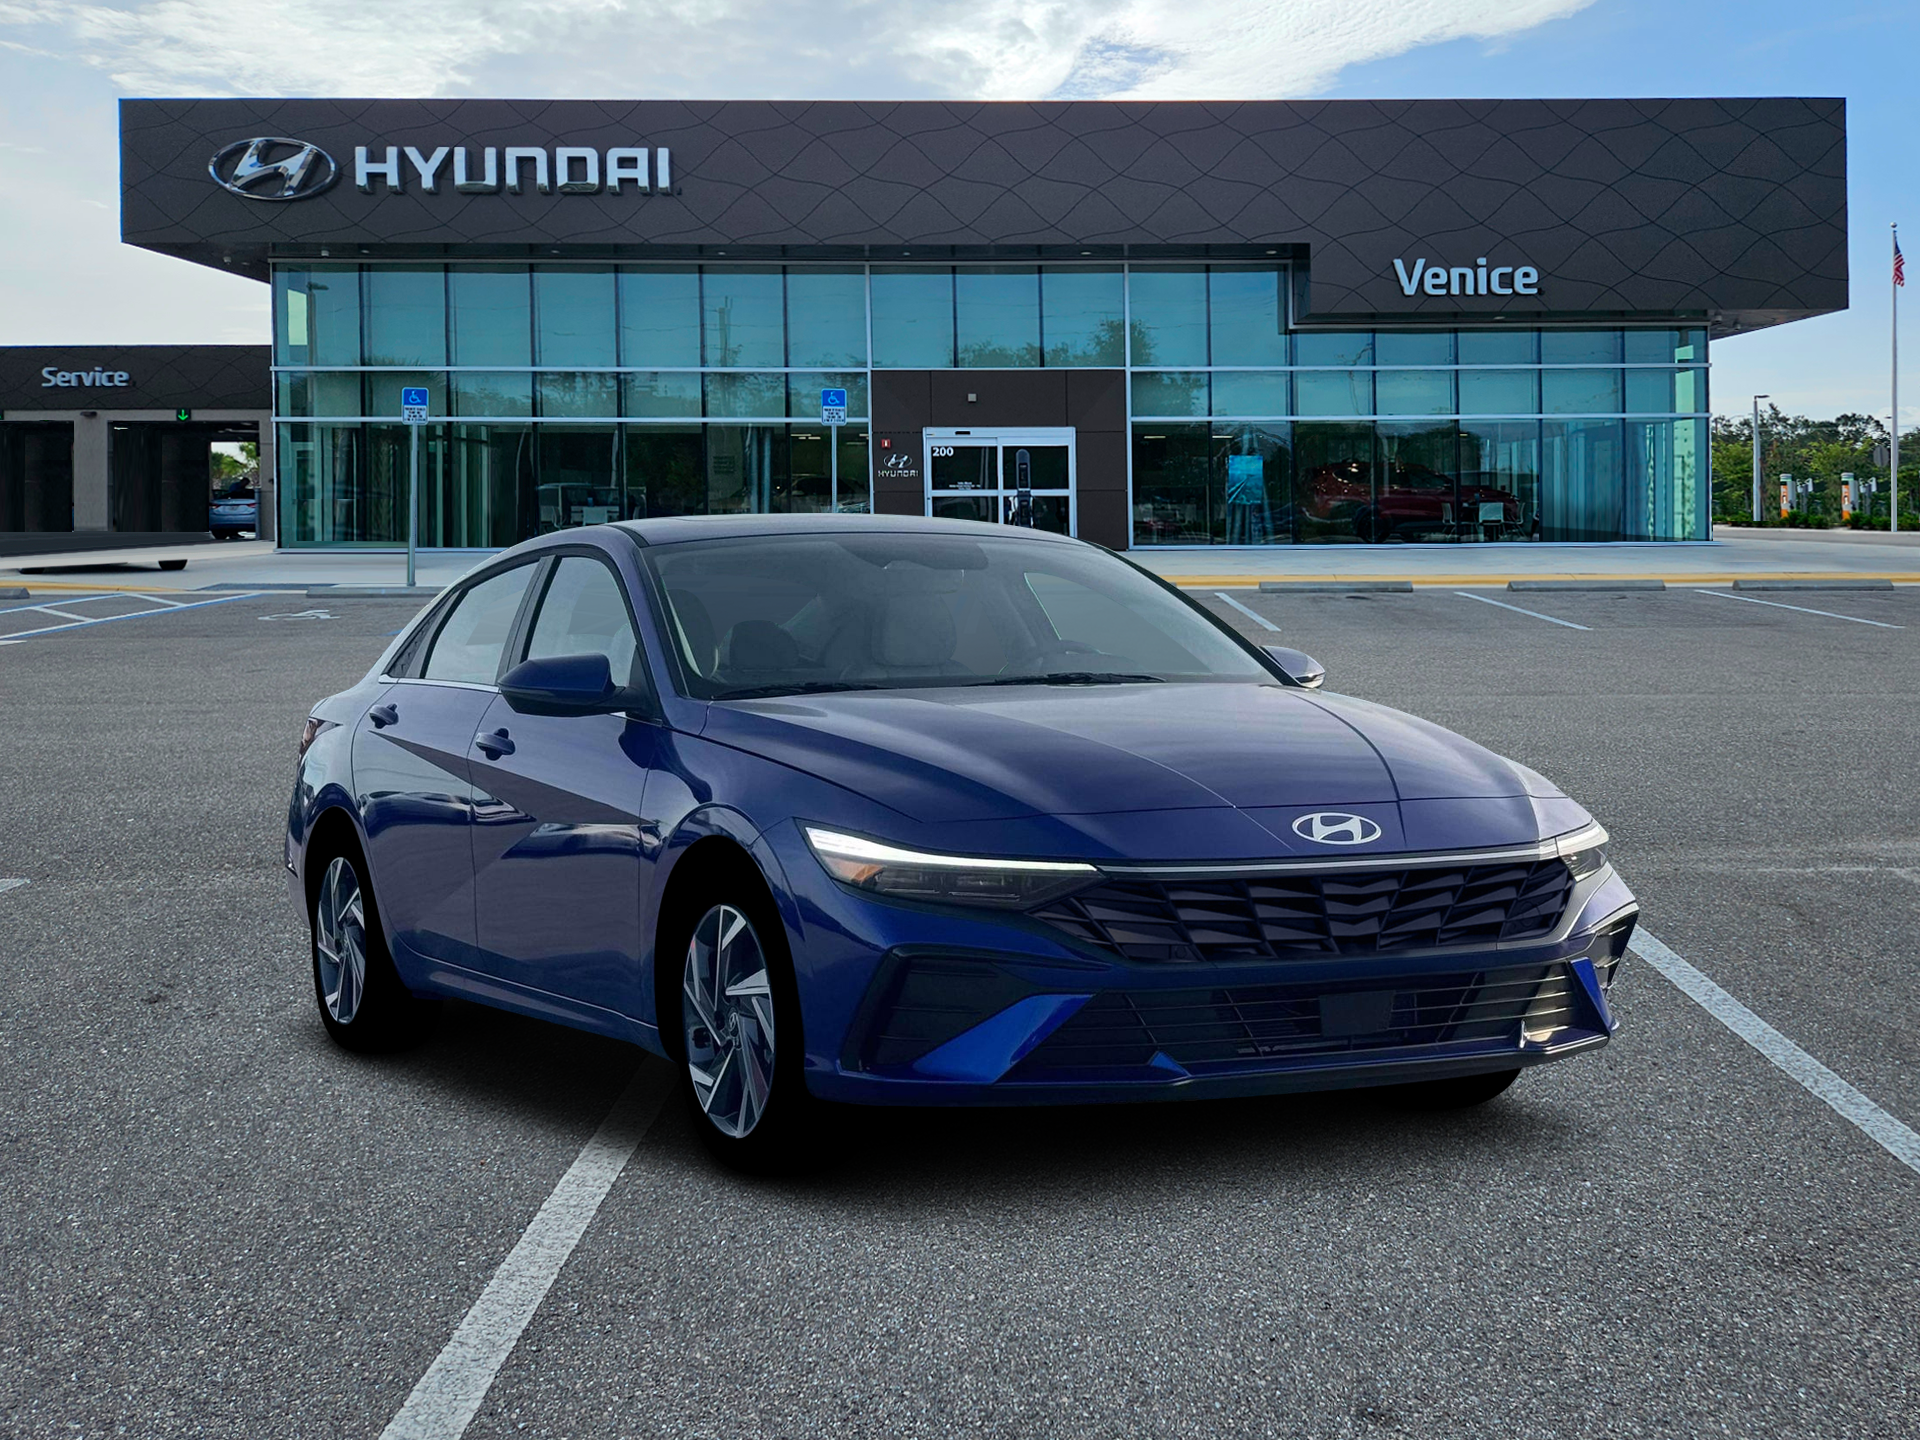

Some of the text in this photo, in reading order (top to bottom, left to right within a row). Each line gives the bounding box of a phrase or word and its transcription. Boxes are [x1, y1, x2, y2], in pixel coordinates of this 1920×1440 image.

[354, 146, 672, 193] HYUNDAI
[1393, 257, 1539, 296] Venice
[41, 366, 130, 387] Service
[932, 446, 954, 457] 200
[877, 469, 919, 478] HYUNDAI
